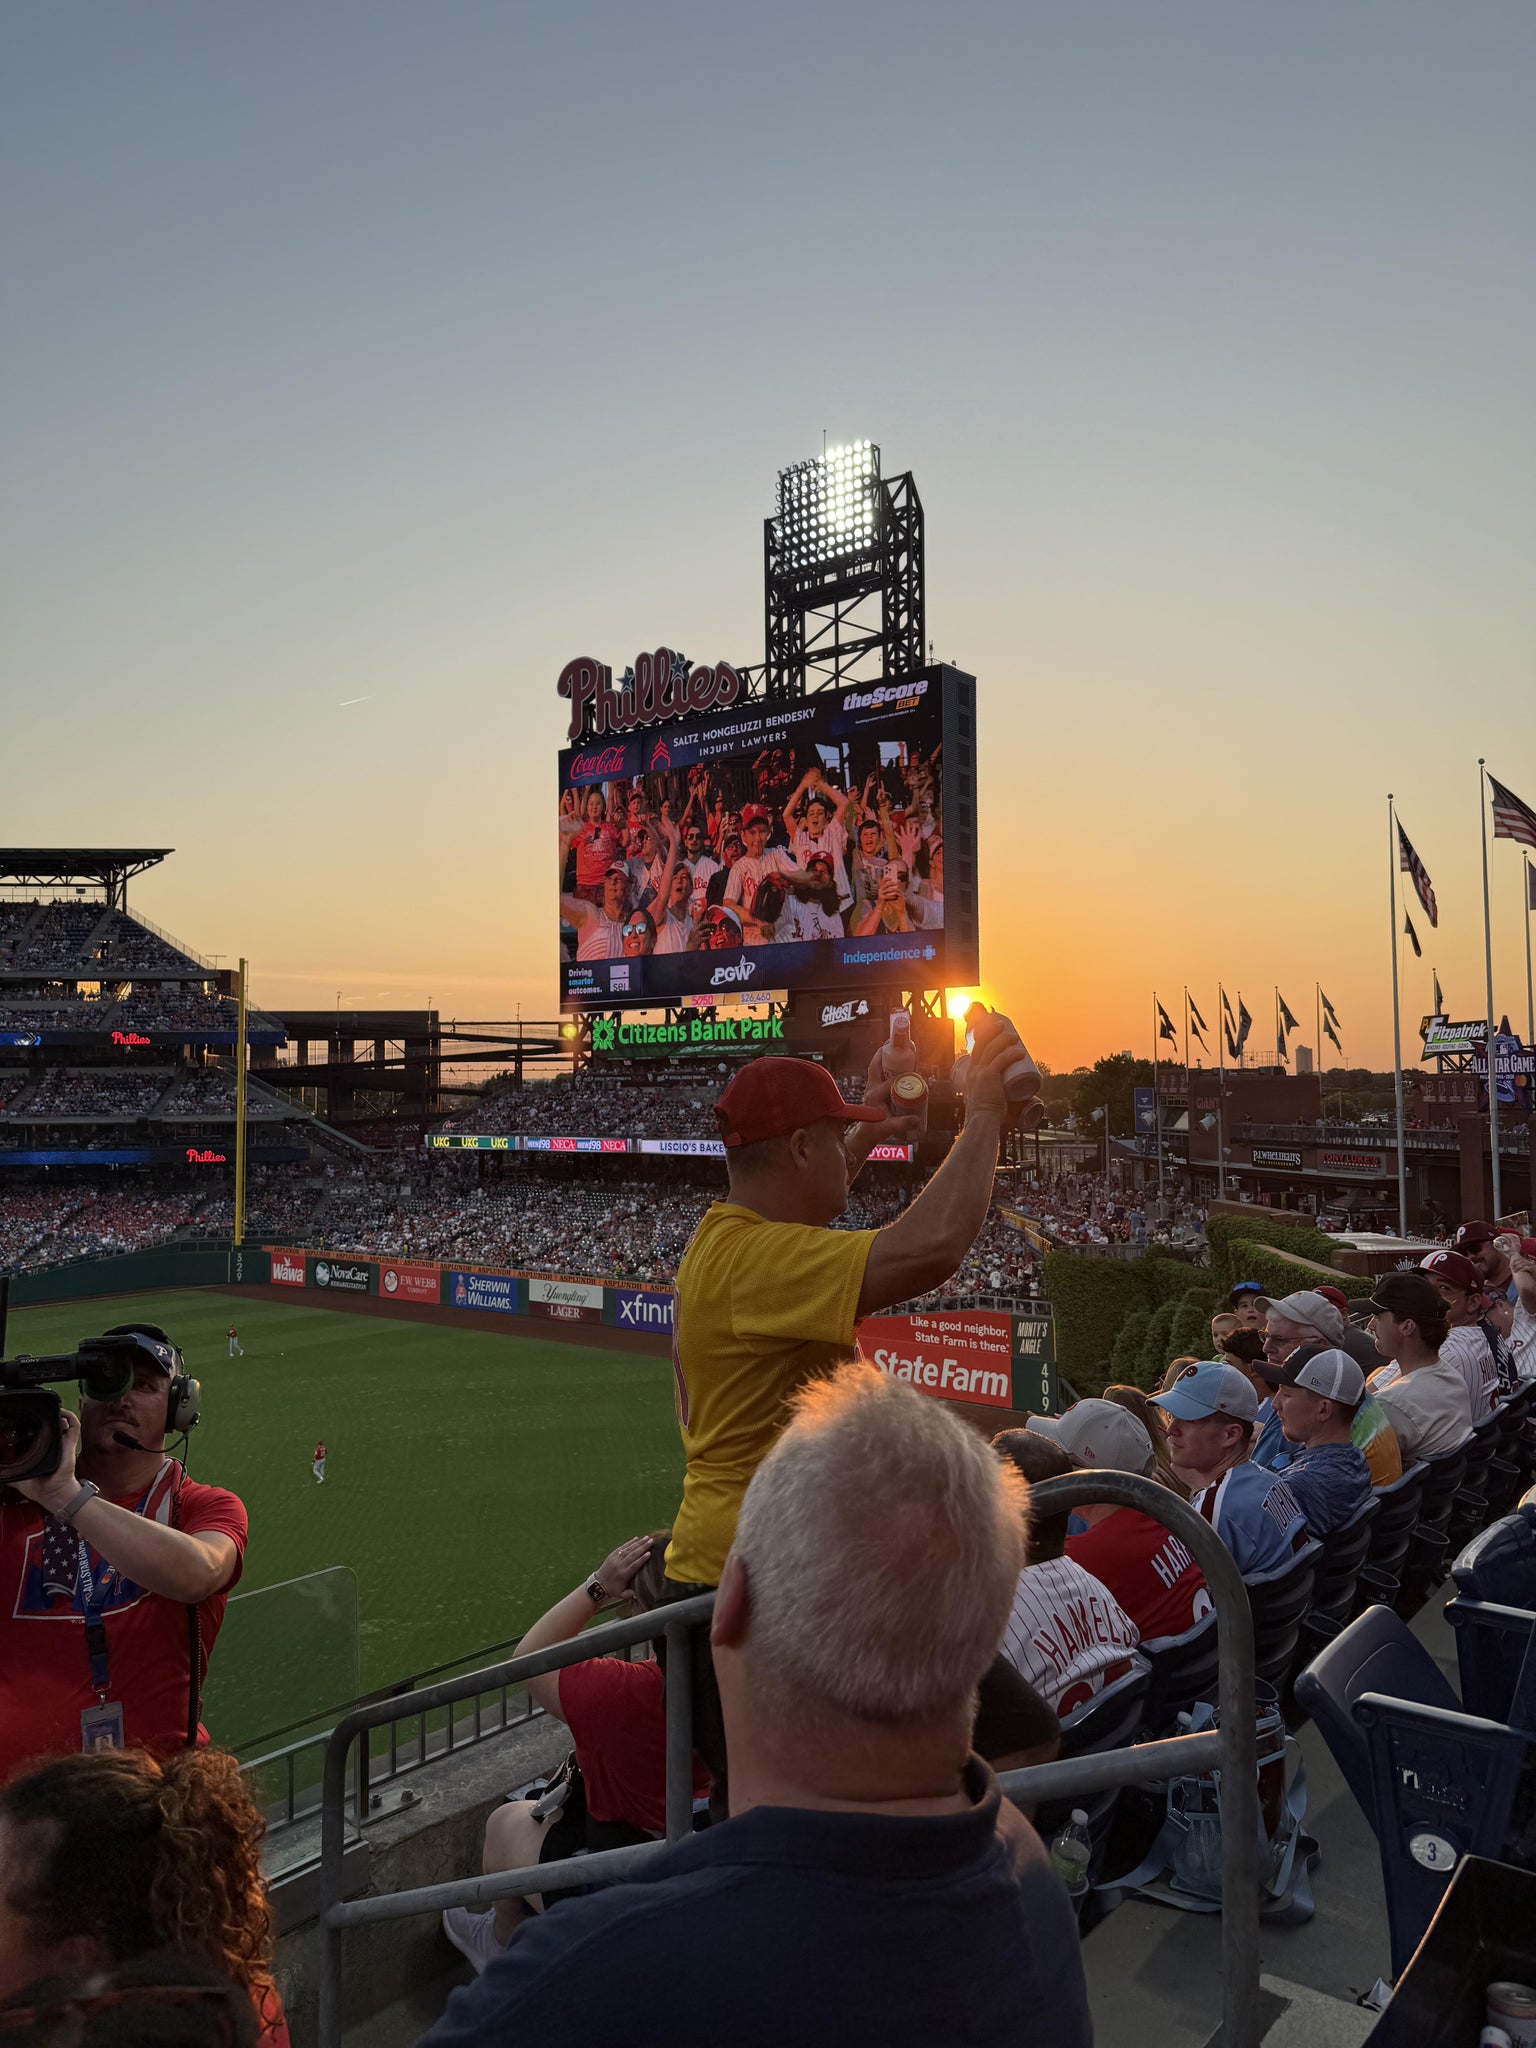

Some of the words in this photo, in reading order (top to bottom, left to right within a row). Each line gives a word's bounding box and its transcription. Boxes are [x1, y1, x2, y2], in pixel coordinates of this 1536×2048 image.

[557, 646, 740, 740] Phillies
[843, 680, 929, 711] theScore
[899, 699, 917, 708] BET
[673, 733, 699, 748] SALTZ
[702, 719, 762, 741] MONGELUZZI
[765, 708, 816, 728] BENDESKY
[699, 742, 735, 757] INJURY
[741, 731, 788, 748] LAWYERS
[843, 948, 921, 965] Independence
[568, 968, 592, 979] Driving
[568, 977, 594, 986] smarter
[714, 965, 751, 983] PGW
[111, 1031, 151, 1045] Phillies
[618, 1023, 687, 1045] Citizens
[690, 1017, 738, 1042] Bank
[741, 1014, 785, 1039] Park
[1425, 1017, 1487, 1043] Fitzpatrick
[1472, 1056, 1488, 1074] ALL
[1511, 1055, 1536, 1073] GAME
[433, 1137, 450, 1147] UKG
[461, 1137, 479, 1148] UKG
[490, 1138, 509, 1149] UKG
[552, 1139, 575, 1149] NECA
[603, 1140, 626, 1151] NECA
[659, 1142, 697, 1152] LISCIO'S
[186, 1148, 226, 1162] Phillies
[1321, 1153, 1344, 1161] TONY
[1346, 1154, 1380, 1164] LUKE'S
[272, 1263, 304, 1282] Wawa
[330, 1265, 369, 1282] NovaCare
[414, 1277, 437, 1289] WEBB
[468, 1277, 511, 1295] SHERWIN
[650, 1285, 674, 1293] ASPLU
[542, 1283, 590, 1305] Yuengling
[550, 1305, 581, 1319] LAGER
[620, 1294, 674, 1325] xfinit
[910, 1316, 929, 1328] Like
[931, 1320, 938, 1329] a
[939, 1318, 962, 1332] good
[964, 1323, 1009, 1339] neighbor,
[1016, 1321, 1048, 1338] MONTY'S
[915, 1331, 940, 1344] State
[943, 1336, 967, 1348] Farm
[969, 1337, 978, 1349] is
[1019, 1339, 1042, 1355] ANGLE
[1033, 1596, 1134, 1675] HAMELS
[1427, 1842, 1437, 1862] 3
